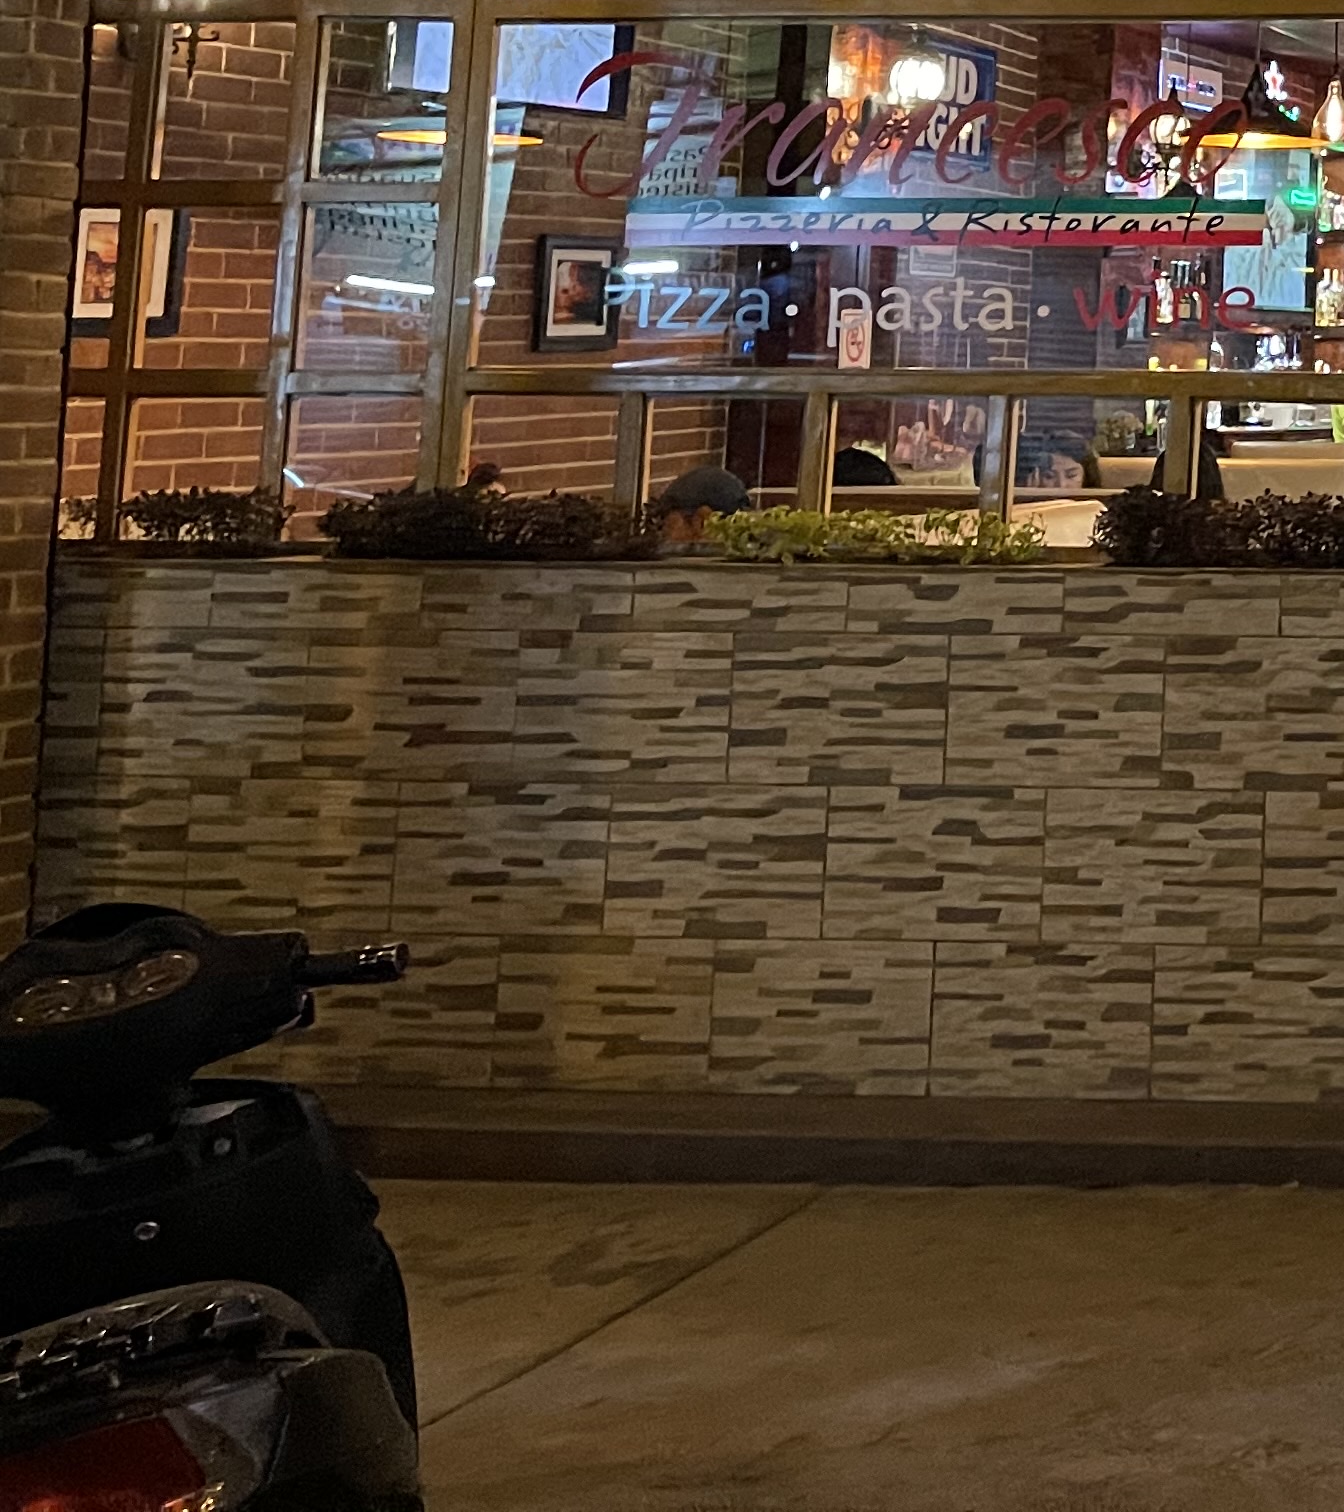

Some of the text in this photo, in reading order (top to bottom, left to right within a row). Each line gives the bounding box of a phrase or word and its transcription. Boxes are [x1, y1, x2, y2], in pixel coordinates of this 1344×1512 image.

[925, 52, 978, 105] UD
[574, 50, 1248, 199] Francesco
[681, 199, 893, 240] Pizzeria
[959, 194, 1225, 244] Ristorante
[826, 277, 1014, 348] pasta
[1073, 272, 1256, 330] wine
